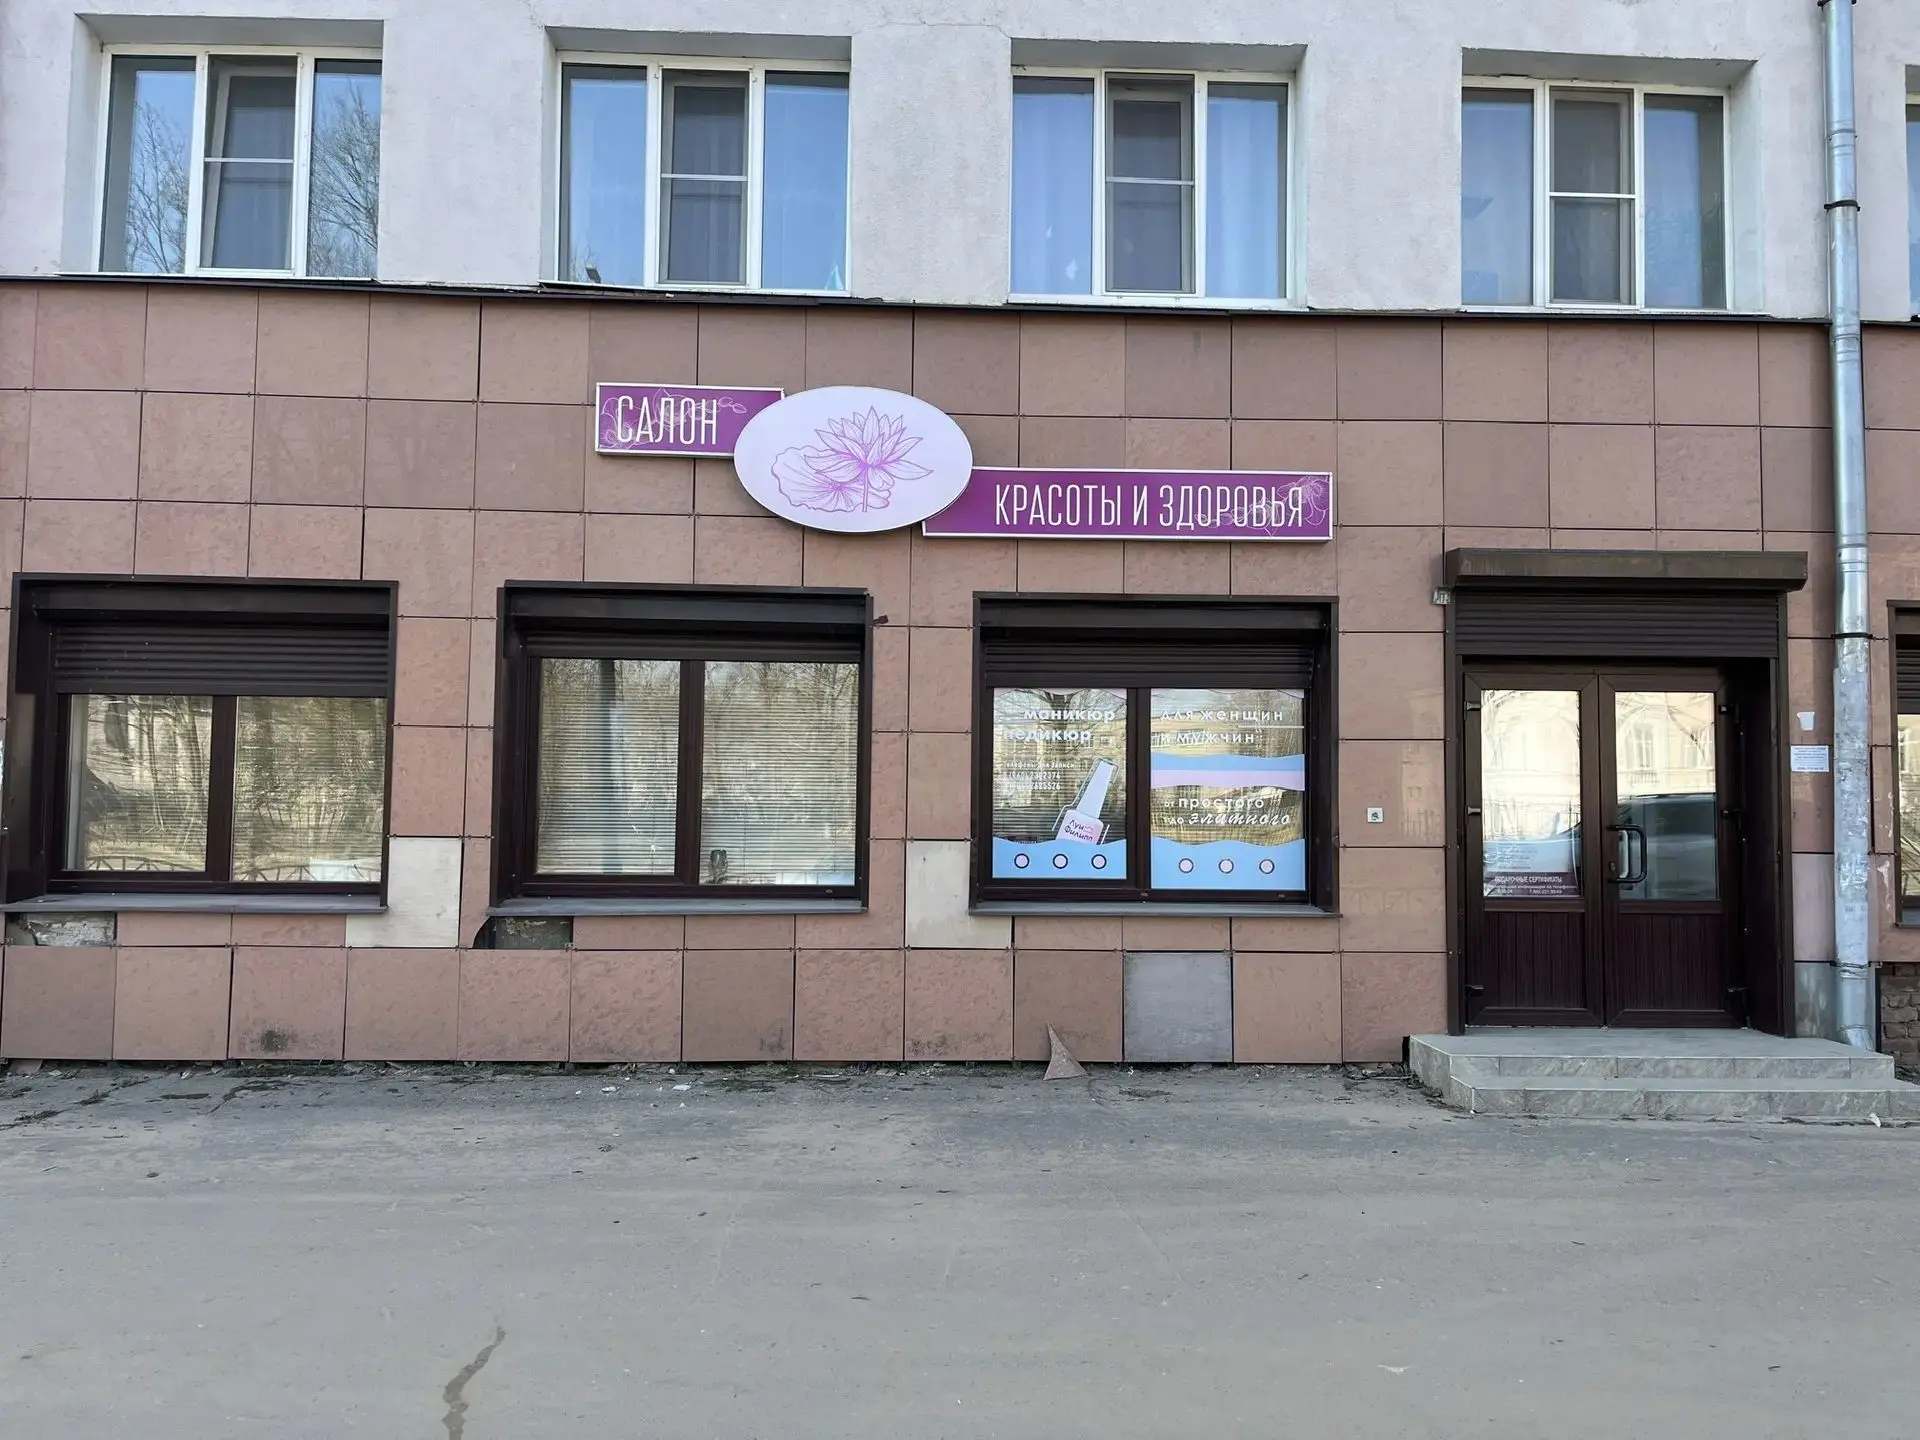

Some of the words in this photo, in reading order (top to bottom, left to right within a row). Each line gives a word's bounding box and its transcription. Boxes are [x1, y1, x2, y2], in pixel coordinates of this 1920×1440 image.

[617, 395, 717, 445] САЛОН
[995, 484, 1121, 527] КРАСОТЫ
[1133, 485, 1148, 527] И
[1159, 485, 1302, 531] ЗДОРОВЬЯ
[1024, 709, 1115, 723] маникюр
[1160, 710, 1194, 721] для
[1200, 710, 1283, 722] женщин
[1176, 733, 1254, 744] мужчин
[1178, 798, 1265, 810] простого
[1069, 819, 1085, 830] Луи
[1188, 813, 1291, 826] элитного
[1064, 825, 1094, 842] Филипп
